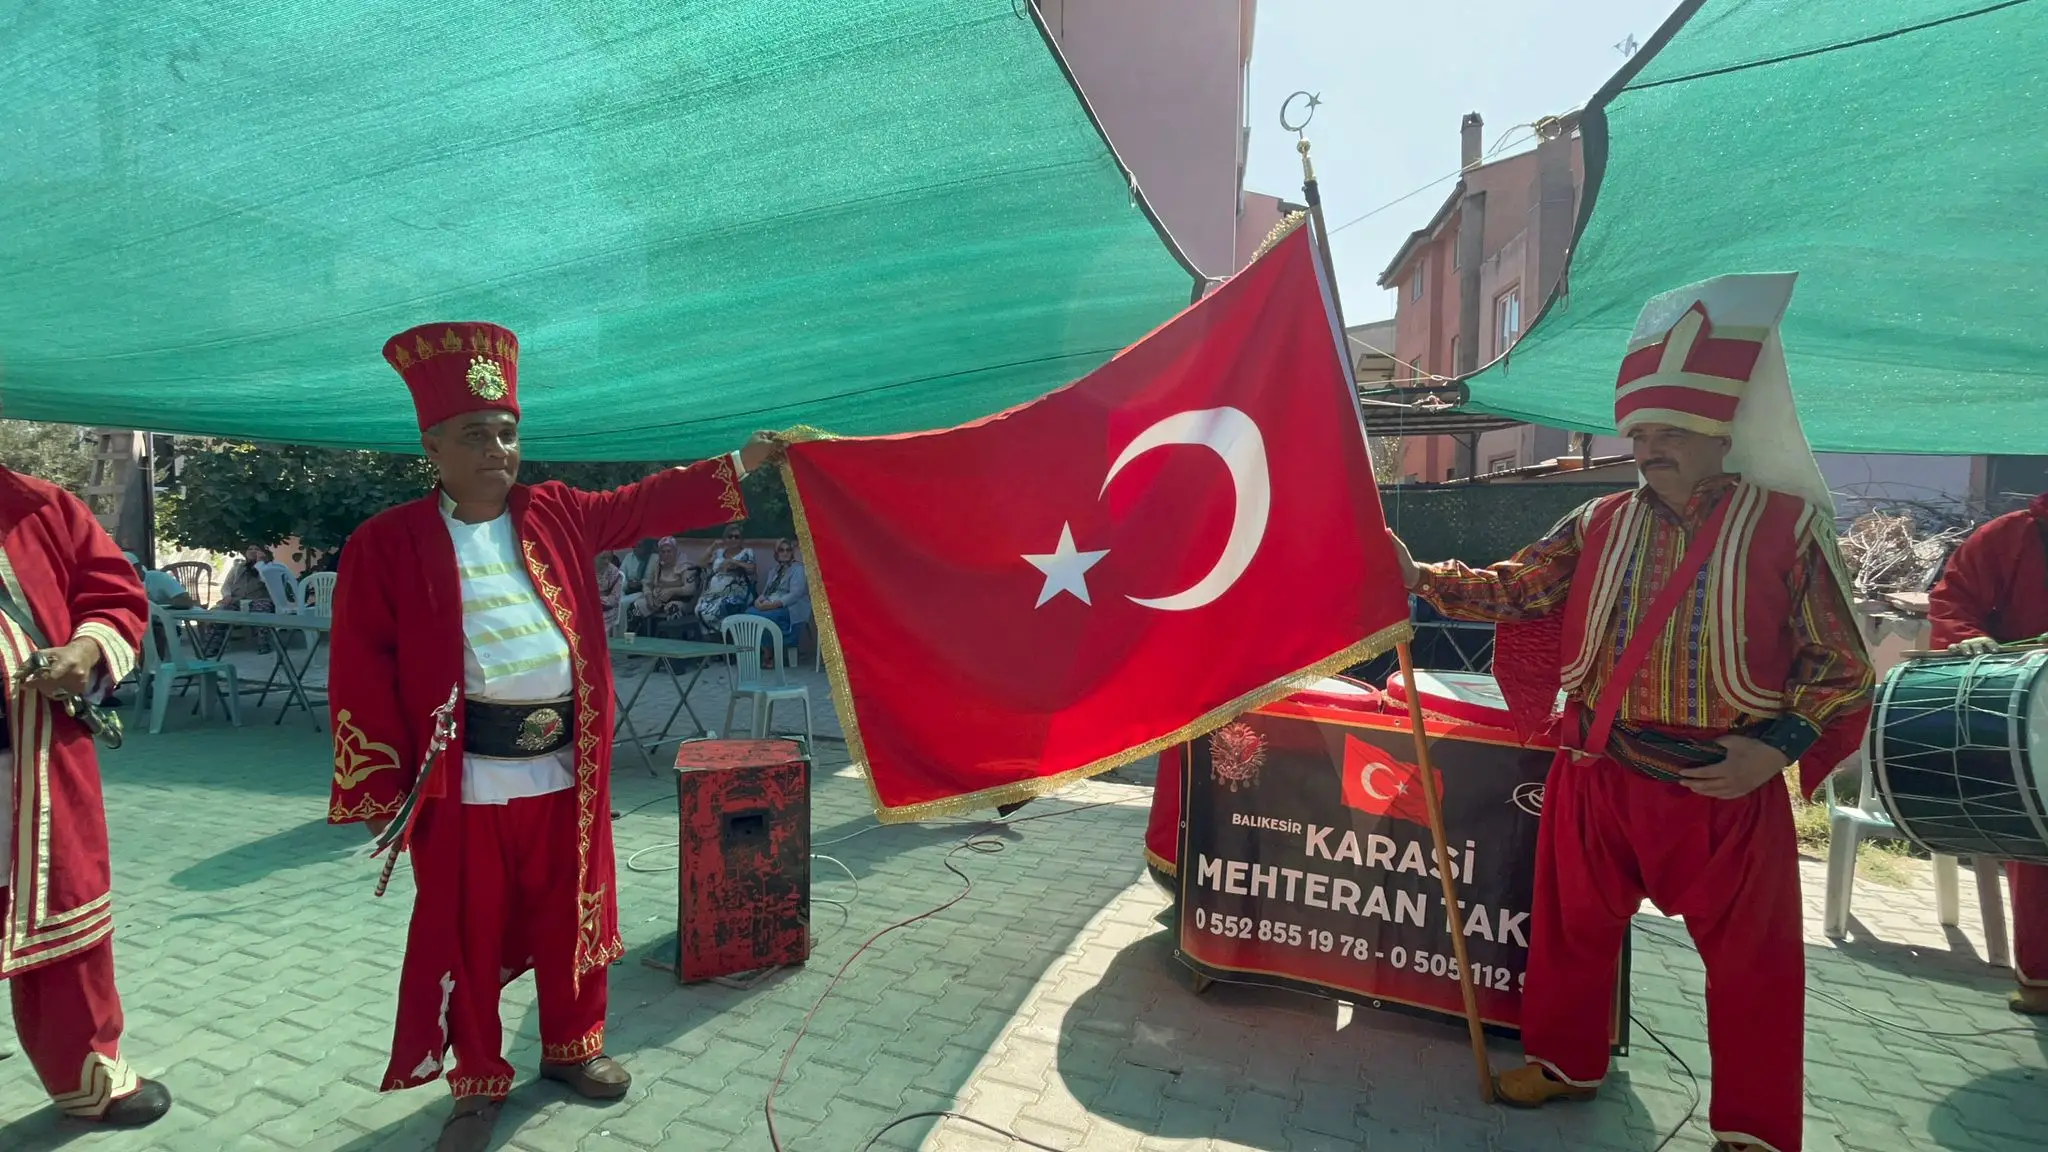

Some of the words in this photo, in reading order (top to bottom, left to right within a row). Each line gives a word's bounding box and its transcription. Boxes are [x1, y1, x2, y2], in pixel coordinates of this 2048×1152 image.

[1232, 813, 1302, 834] BALIKESİR
[1305, 824, 1476, 885] KARASİ
[1197, 853, 1427, 928] MEHTERAN
[1195, 907, 1206, 929] 0
[1210, 912, 1252, 939] 552
[1257, 919, 1302, 947] 855
[1308, 929, 1334, 953] 19
[1340, 935, 1369, 961] 78
[1390, 946, 1407, 969] 0
[1413, 950, 1461, 981] 505
[1471, 962, 1511, 991] 112
